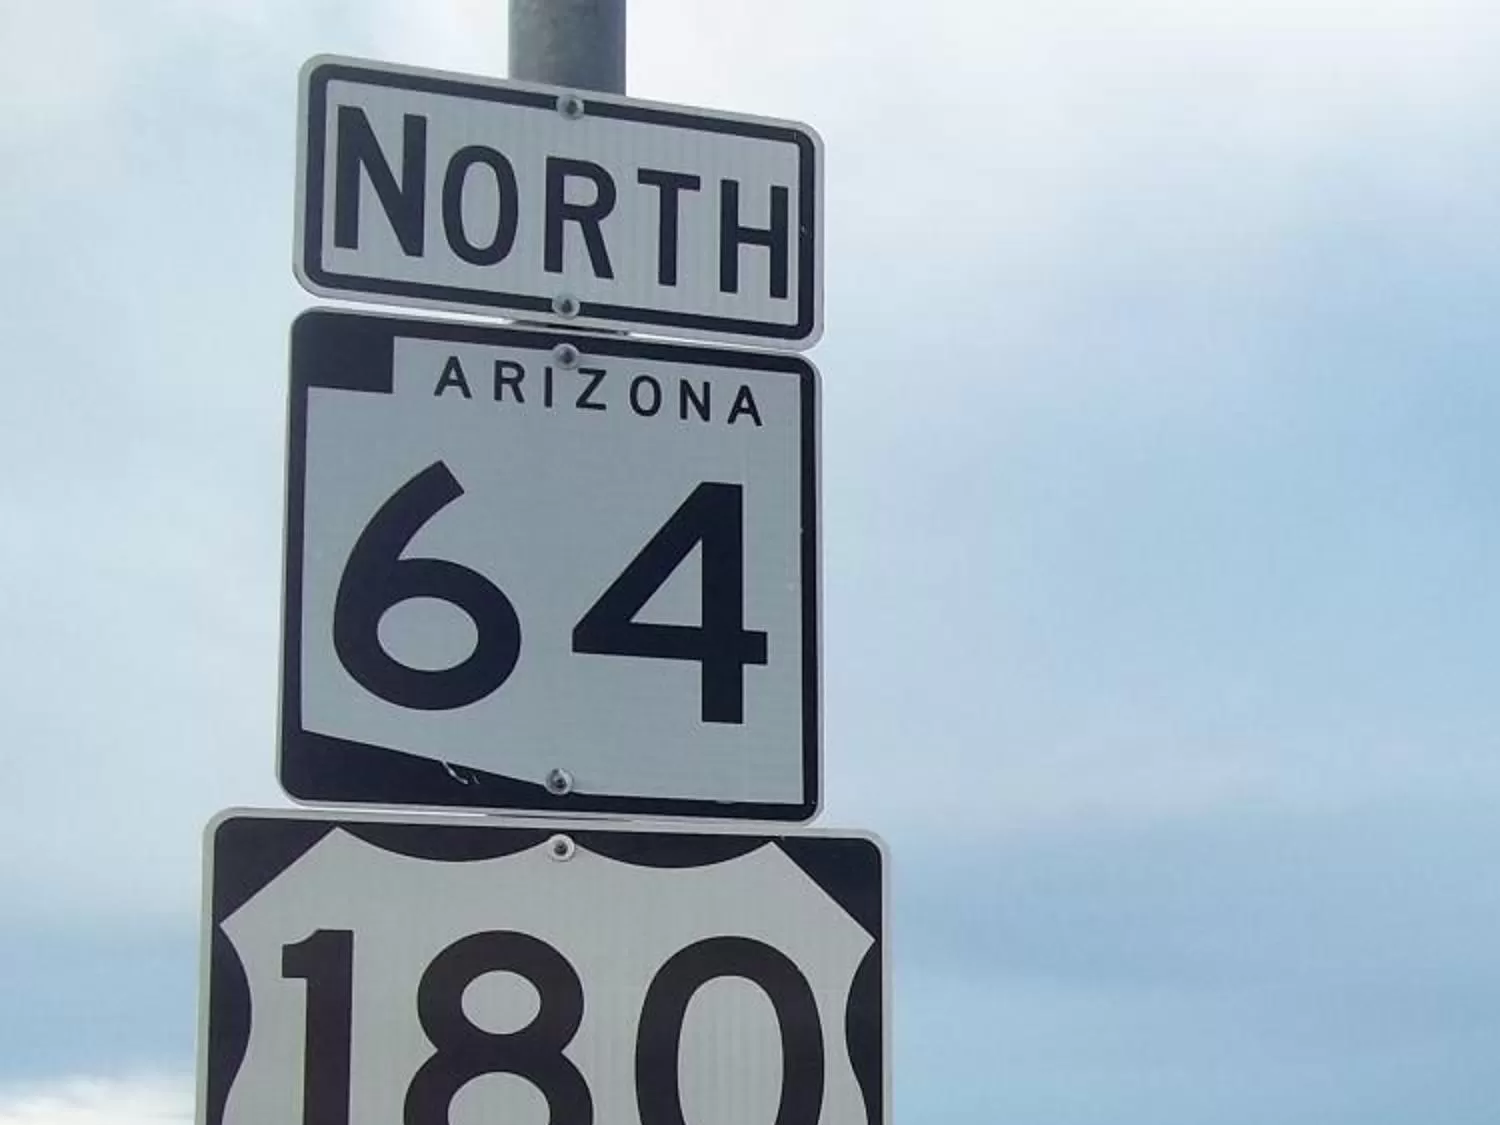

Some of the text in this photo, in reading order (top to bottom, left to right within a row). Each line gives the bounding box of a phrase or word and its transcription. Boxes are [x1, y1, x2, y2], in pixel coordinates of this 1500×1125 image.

[333, 104, 789, 300] NORTH
[433, 355, 763, 428] ARIZONA
[332, 459, 769, 725] 64
